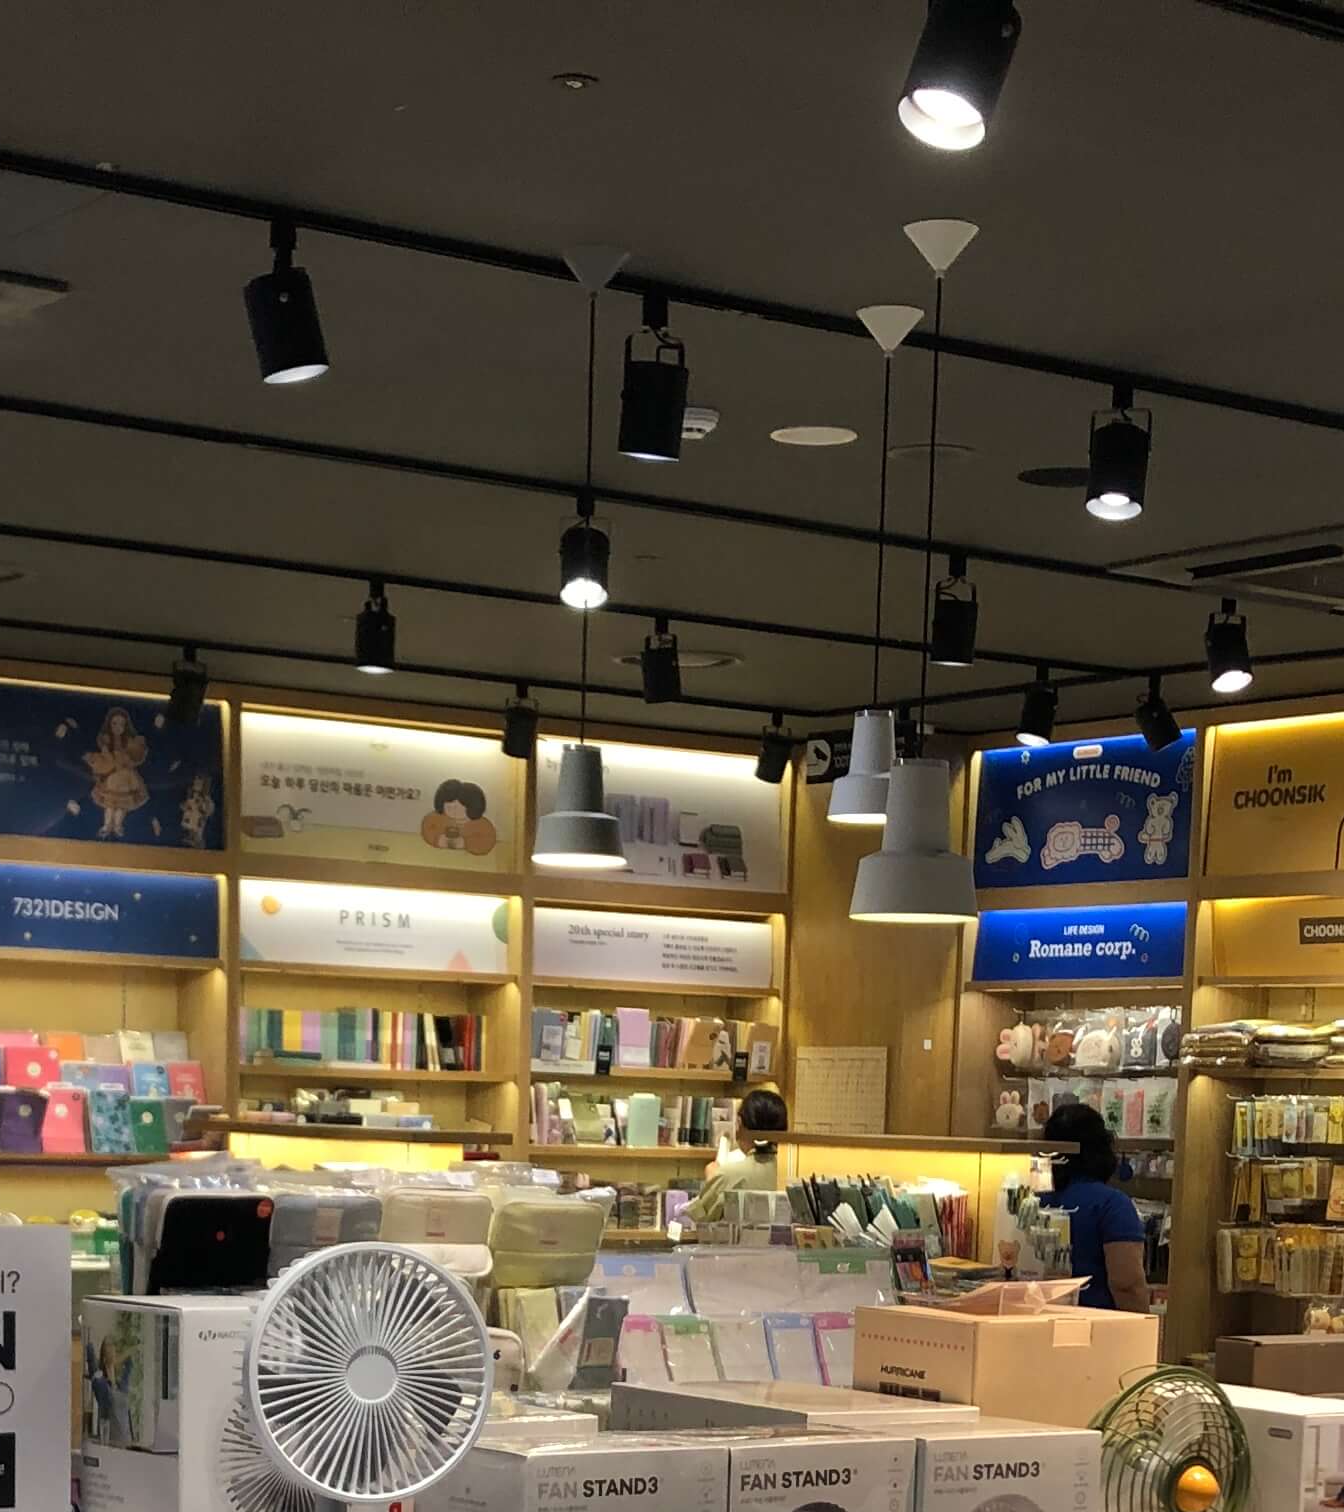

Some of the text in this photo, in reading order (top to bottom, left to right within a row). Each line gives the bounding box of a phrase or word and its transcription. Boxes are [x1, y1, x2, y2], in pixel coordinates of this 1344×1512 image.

[1016, 764, 1161, 800] FOR MY LITTLE FRIEND
[1267, 765, 1292, 783] I'm
[1233, 784, 1326, 810] CHOONSIK
[13, 897, 120, 921] 7321DESIGN
[339, 909, 411, 929] PRISM
[568, 924, 650, 941] 20th special story
[1063, 924, 1105, 937] LIFE DESIGN
[1028, 940, 1136, 960] Romane corp.
[880, 1364, 927, 1380] HURRICANE
[740, 1467, 852, 1492] FAN STAND3
[933, 1461, 1041, 1482] FAN STAND3
[537, 1477, 660, 1501] FAN STAND3
